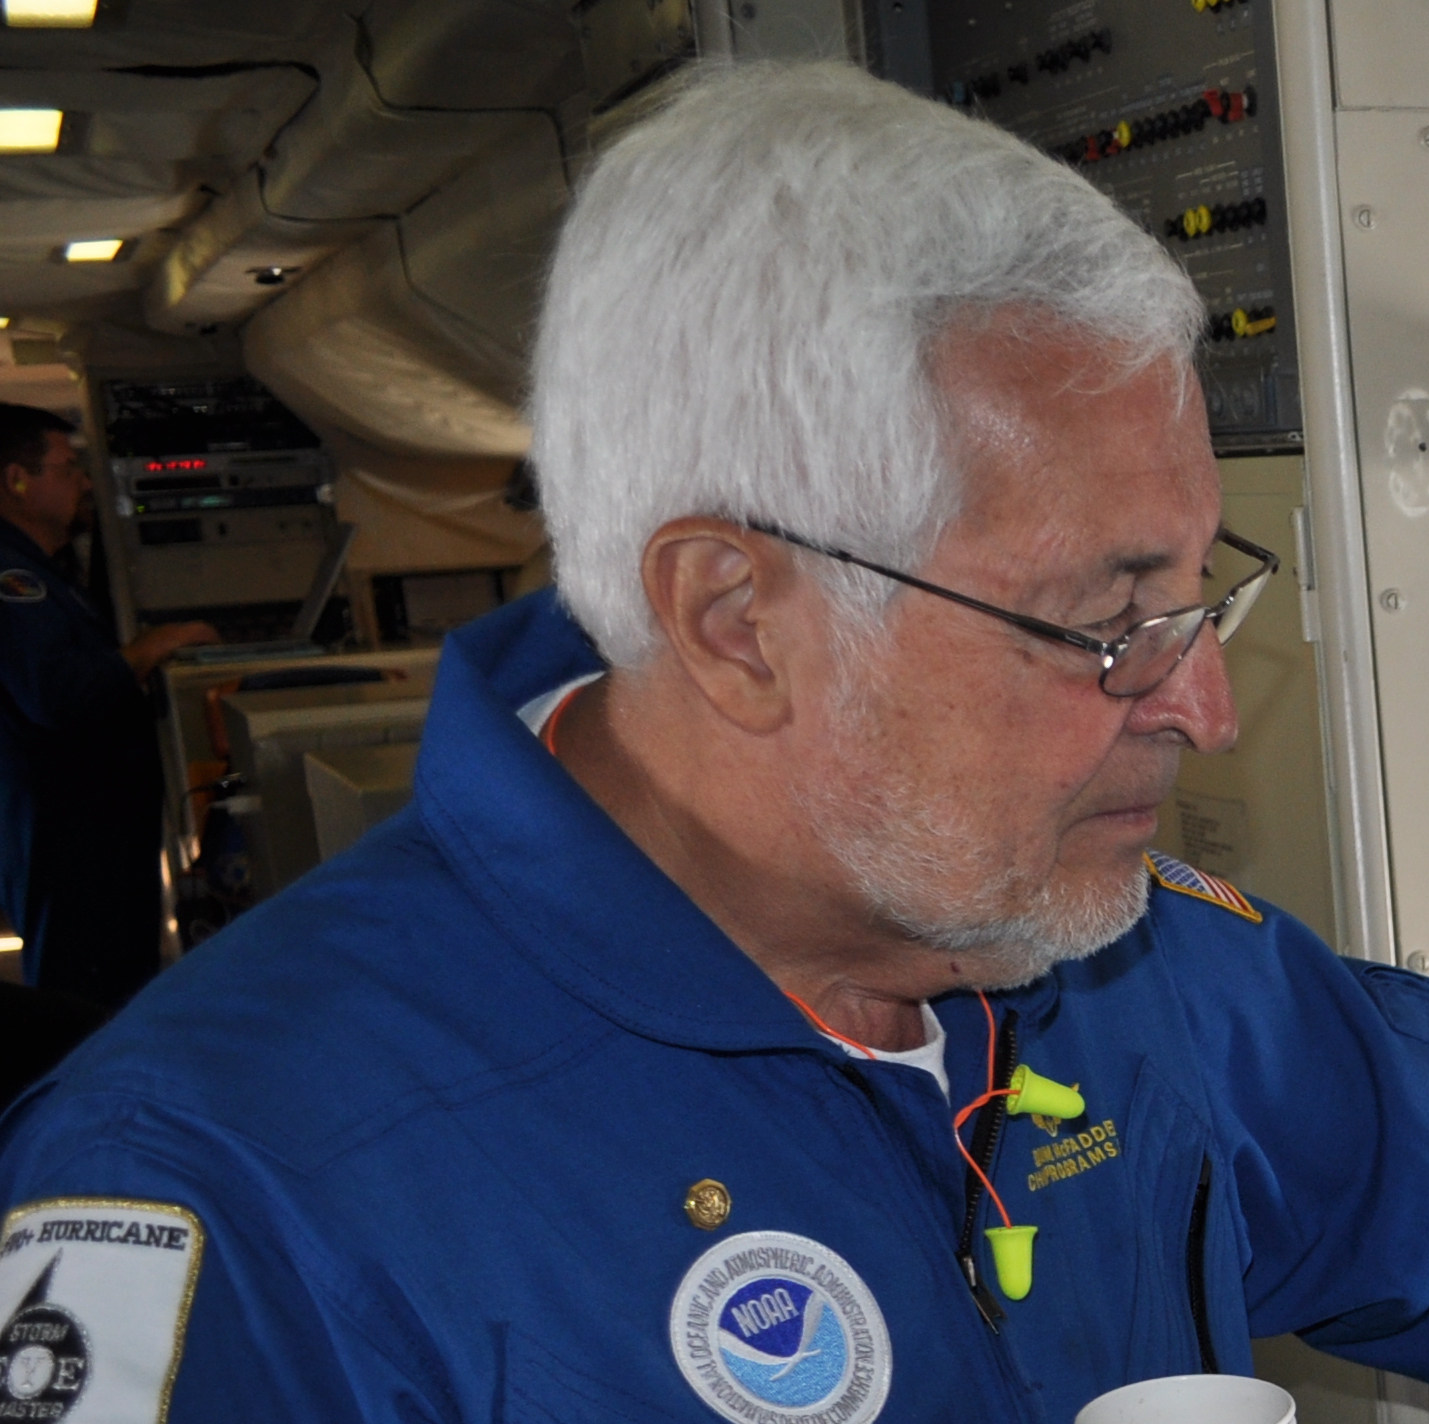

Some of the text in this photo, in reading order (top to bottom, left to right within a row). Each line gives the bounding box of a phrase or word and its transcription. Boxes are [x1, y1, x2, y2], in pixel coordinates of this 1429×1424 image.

[37, 1220, 189, 1251] HURRICANE
[723, 1247, 813, 1281] ATMOSPHERIC
[812, 1264, 875, 1363] ADMINISTRATION
[731, 1288, 799, 1338] NOAA
[10, 1322, 69, 1342] STORM
